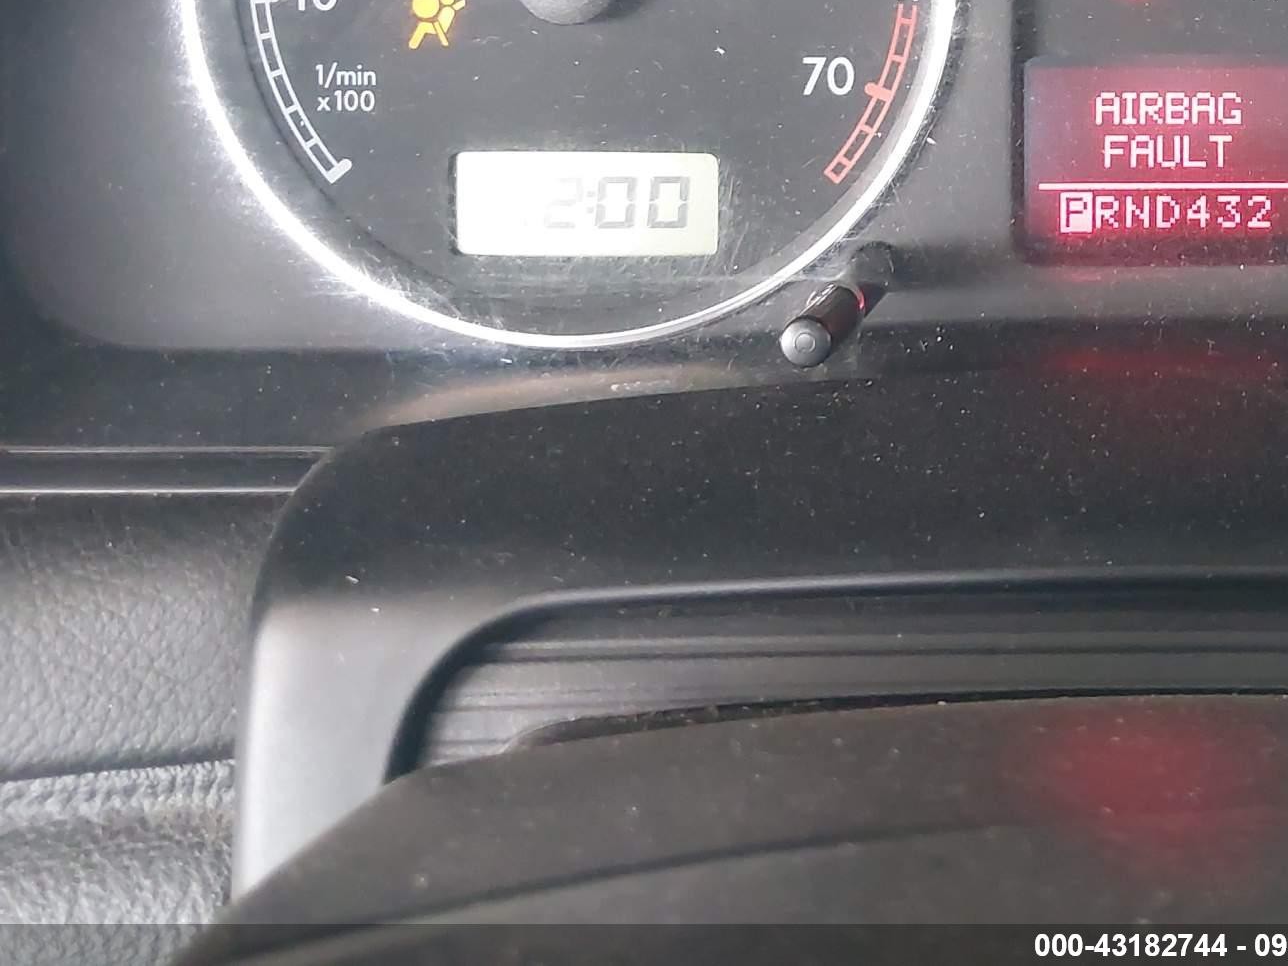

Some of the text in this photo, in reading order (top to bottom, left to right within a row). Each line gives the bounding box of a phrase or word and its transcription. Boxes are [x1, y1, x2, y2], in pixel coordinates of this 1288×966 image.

[315, 61, 377, 88] 1/min
[802, 56, 855, 96] 70
[316, 89, 375, 112] x100
[1095, 91, 1242, 126] AIRBAG
[1103, 134, 1233, 168] FAULT
